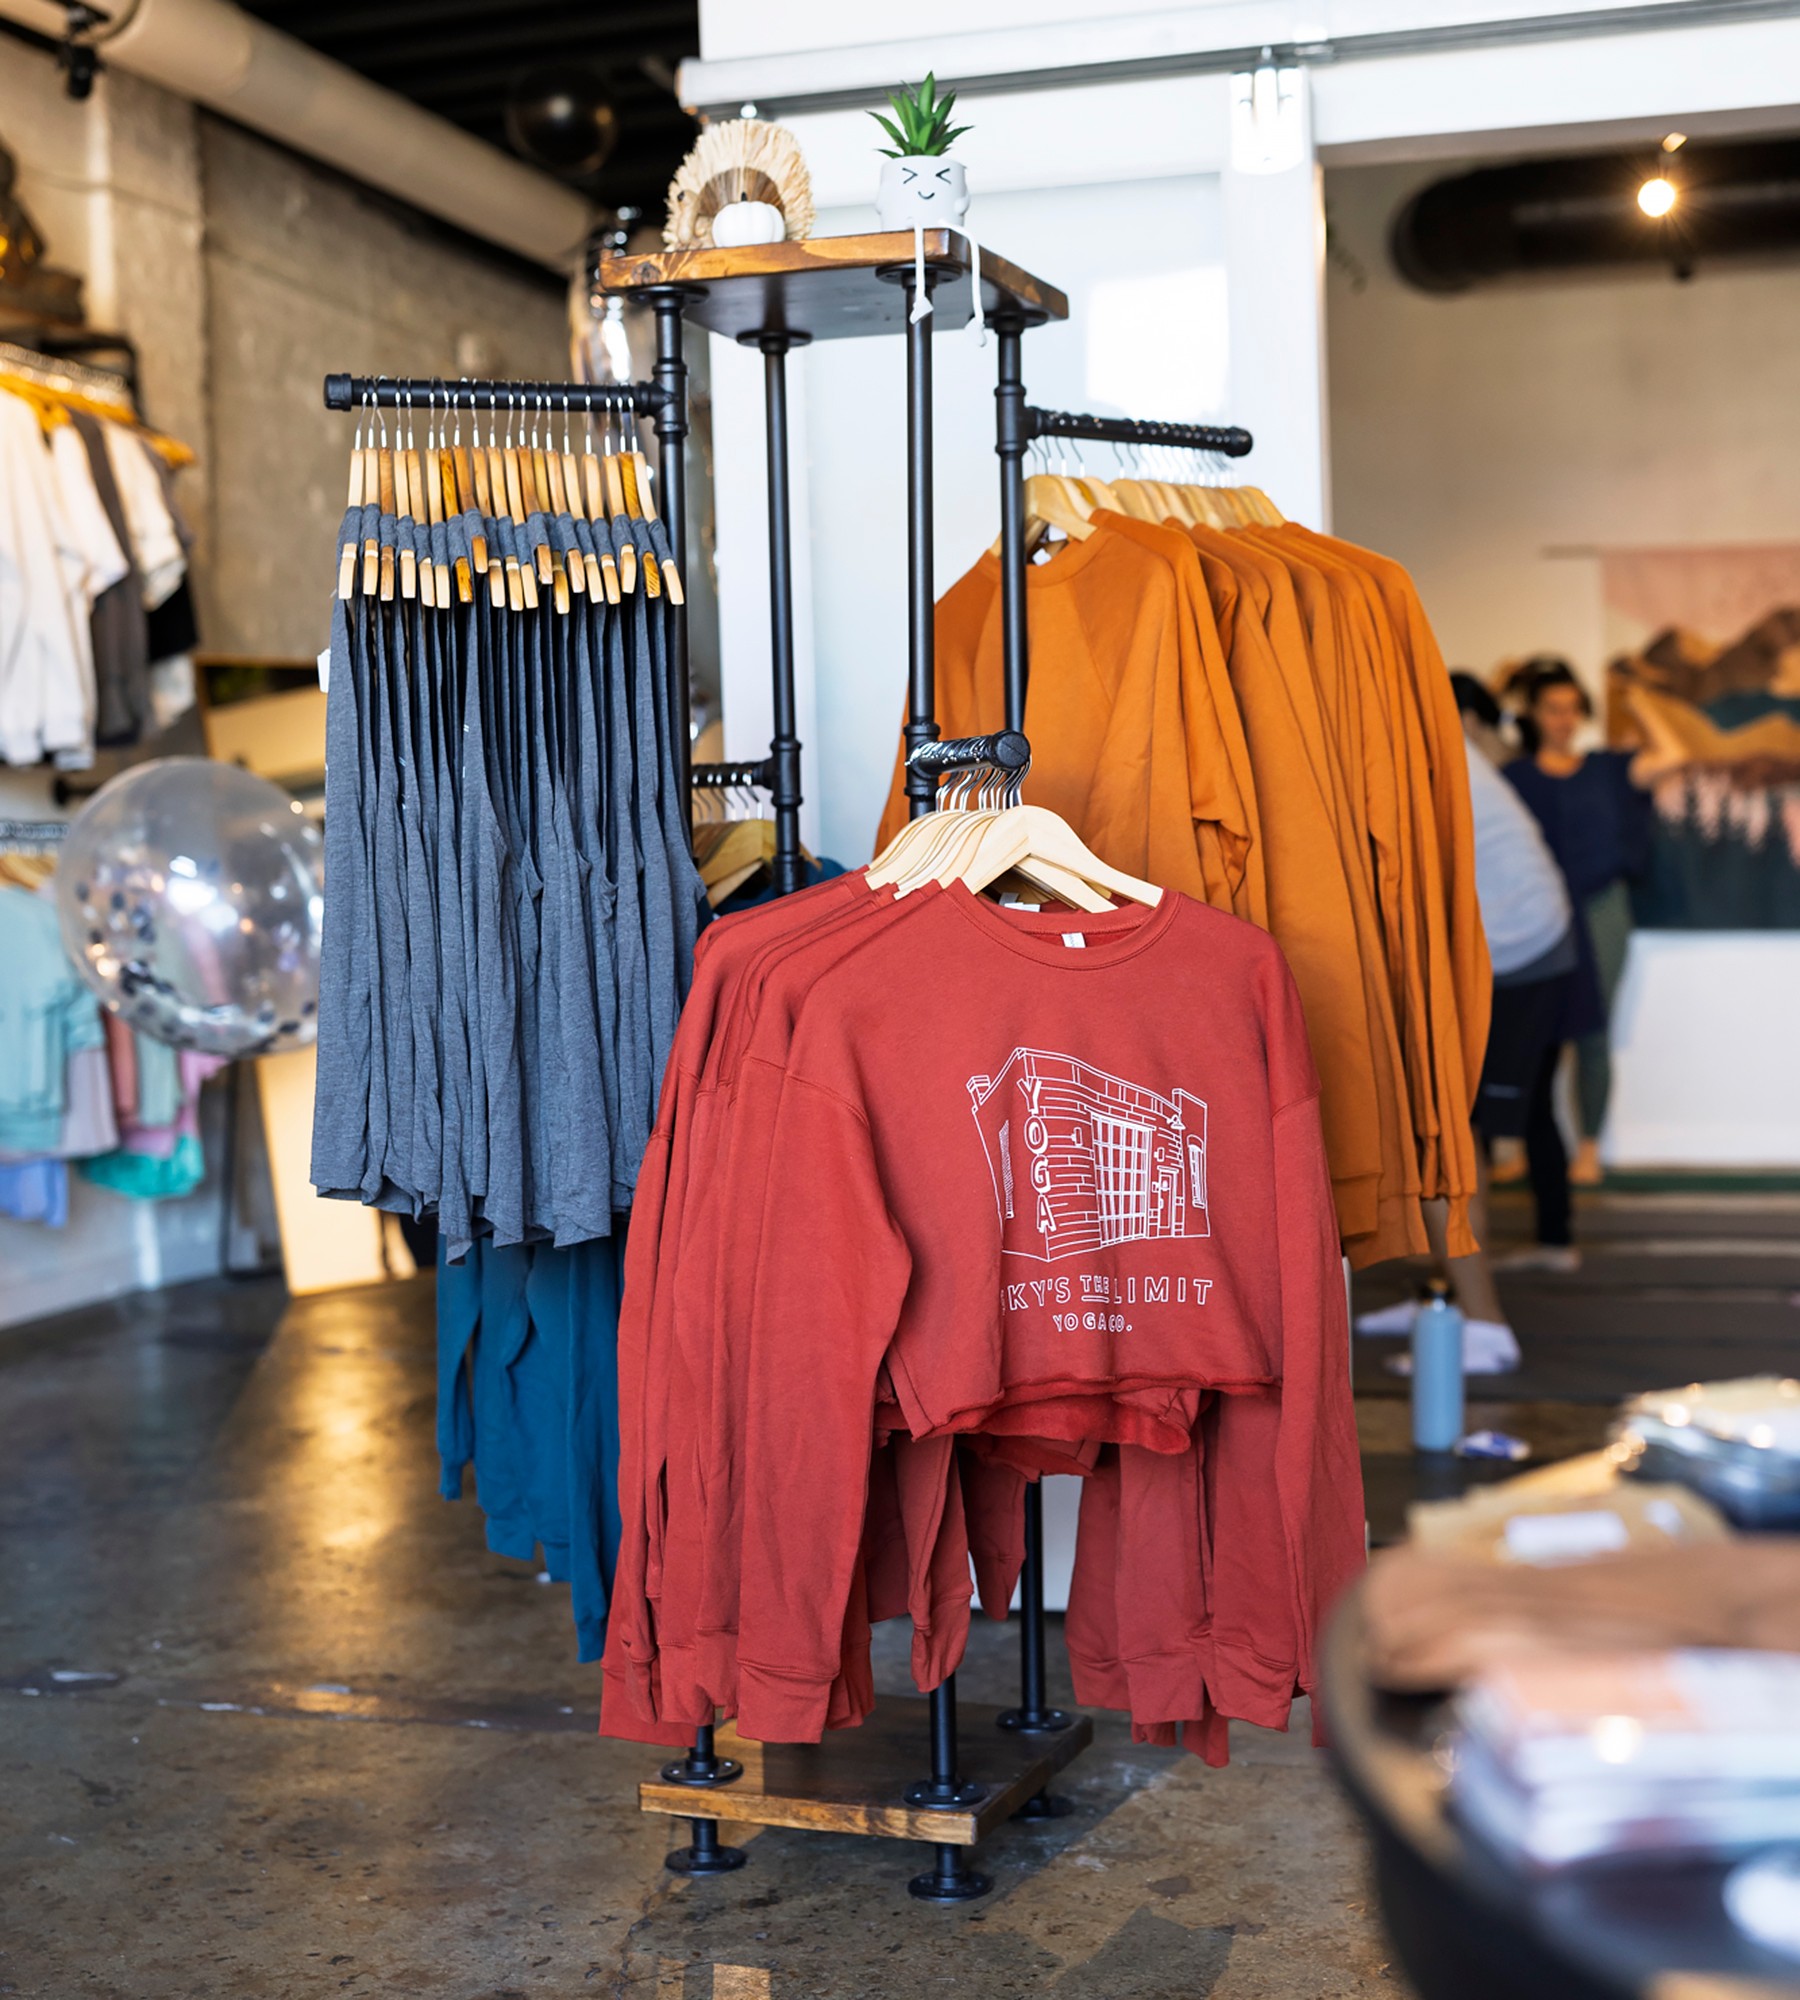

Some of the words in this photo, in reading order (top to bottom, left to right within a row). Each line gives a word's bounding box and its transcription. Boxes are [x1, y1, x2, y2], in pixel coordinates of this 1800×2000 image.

[1016, 1077, 1057, 1233] YOGA
[1000, 1277, 1072, 1316] KY'S
[1080, 1275, 1110, 1295] THE
[1113, 1276, 1213, 1306] LIMIT
